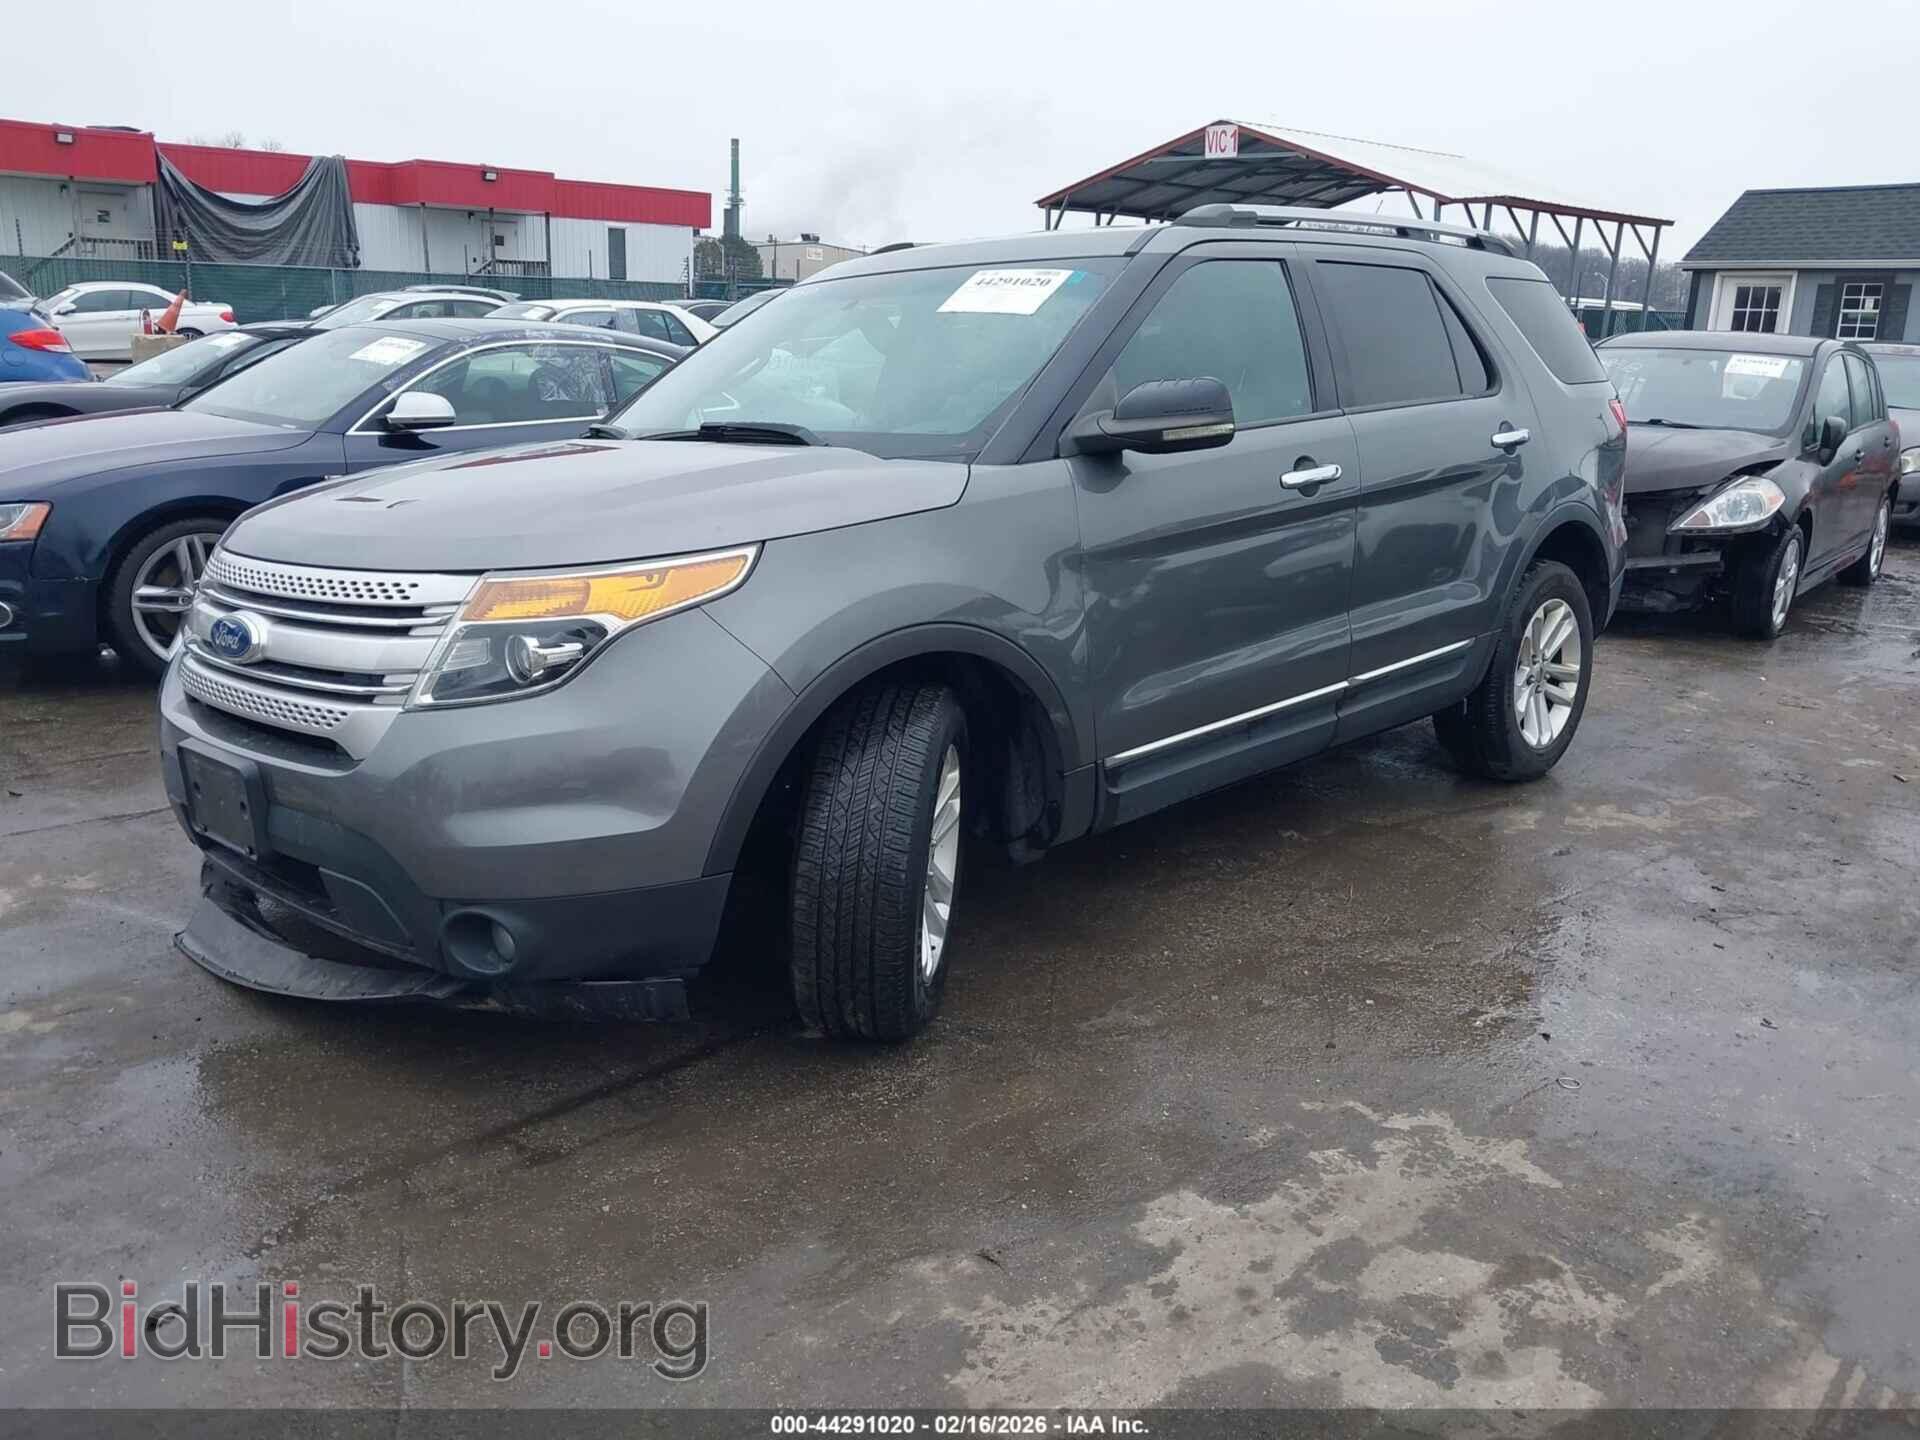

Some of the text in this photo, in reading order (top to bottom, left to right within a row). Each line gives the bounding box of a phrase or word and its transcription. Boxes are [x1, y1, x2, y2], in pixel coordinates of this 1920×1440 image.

[1206, 129, 1237, 153] VIC 1
[213, 620, 242, 649] Ford
